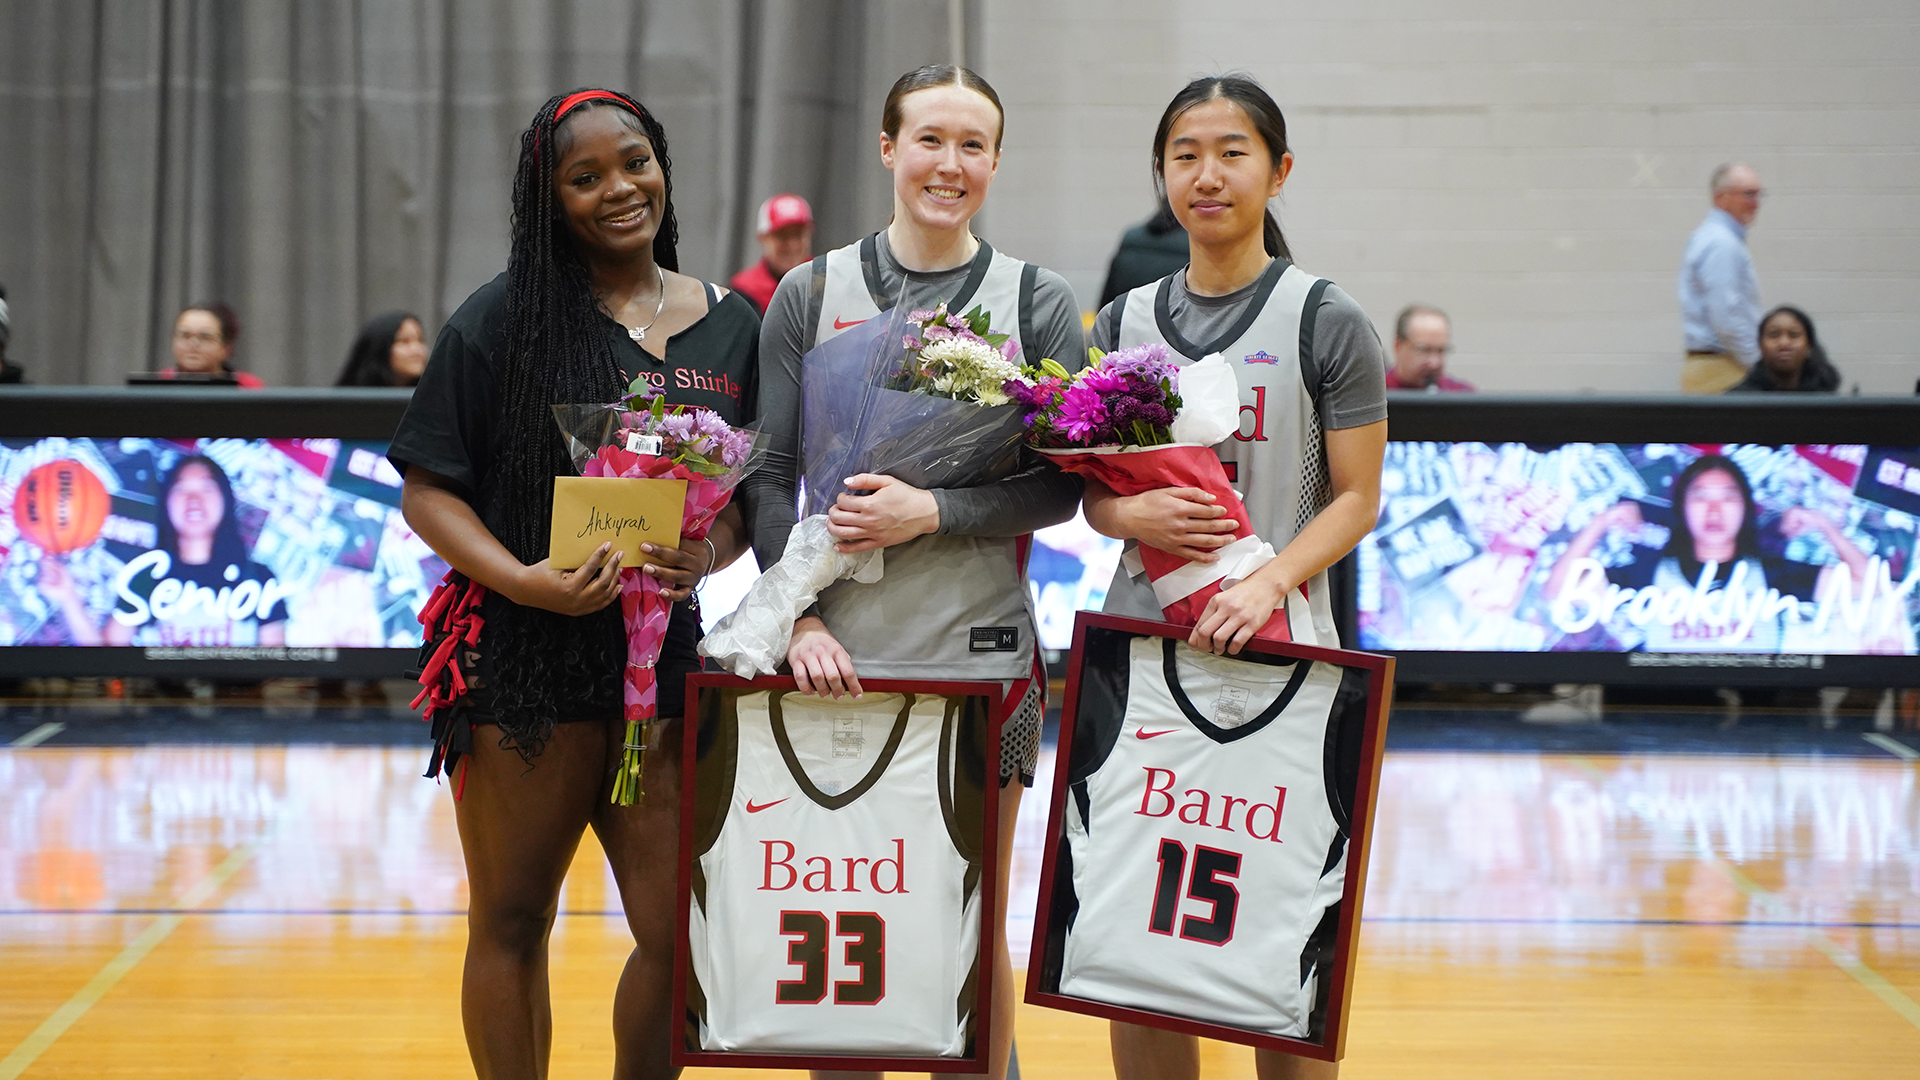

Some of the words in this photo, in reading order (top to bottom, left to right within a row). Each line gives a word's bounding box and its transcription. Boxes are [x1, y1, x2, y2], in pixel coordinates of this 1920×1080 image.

[112, 549, 296, 626] Senior
[1552, 558, 1800, 647] Brooklyn
[1003, 634, 1012, 644] M
[1134, 766, 1287, 844] Bard
[757, 838, 910, 894] Bard
[1148, 837, 1243, 947] 15
[775, 910, 886, 1005] 33
